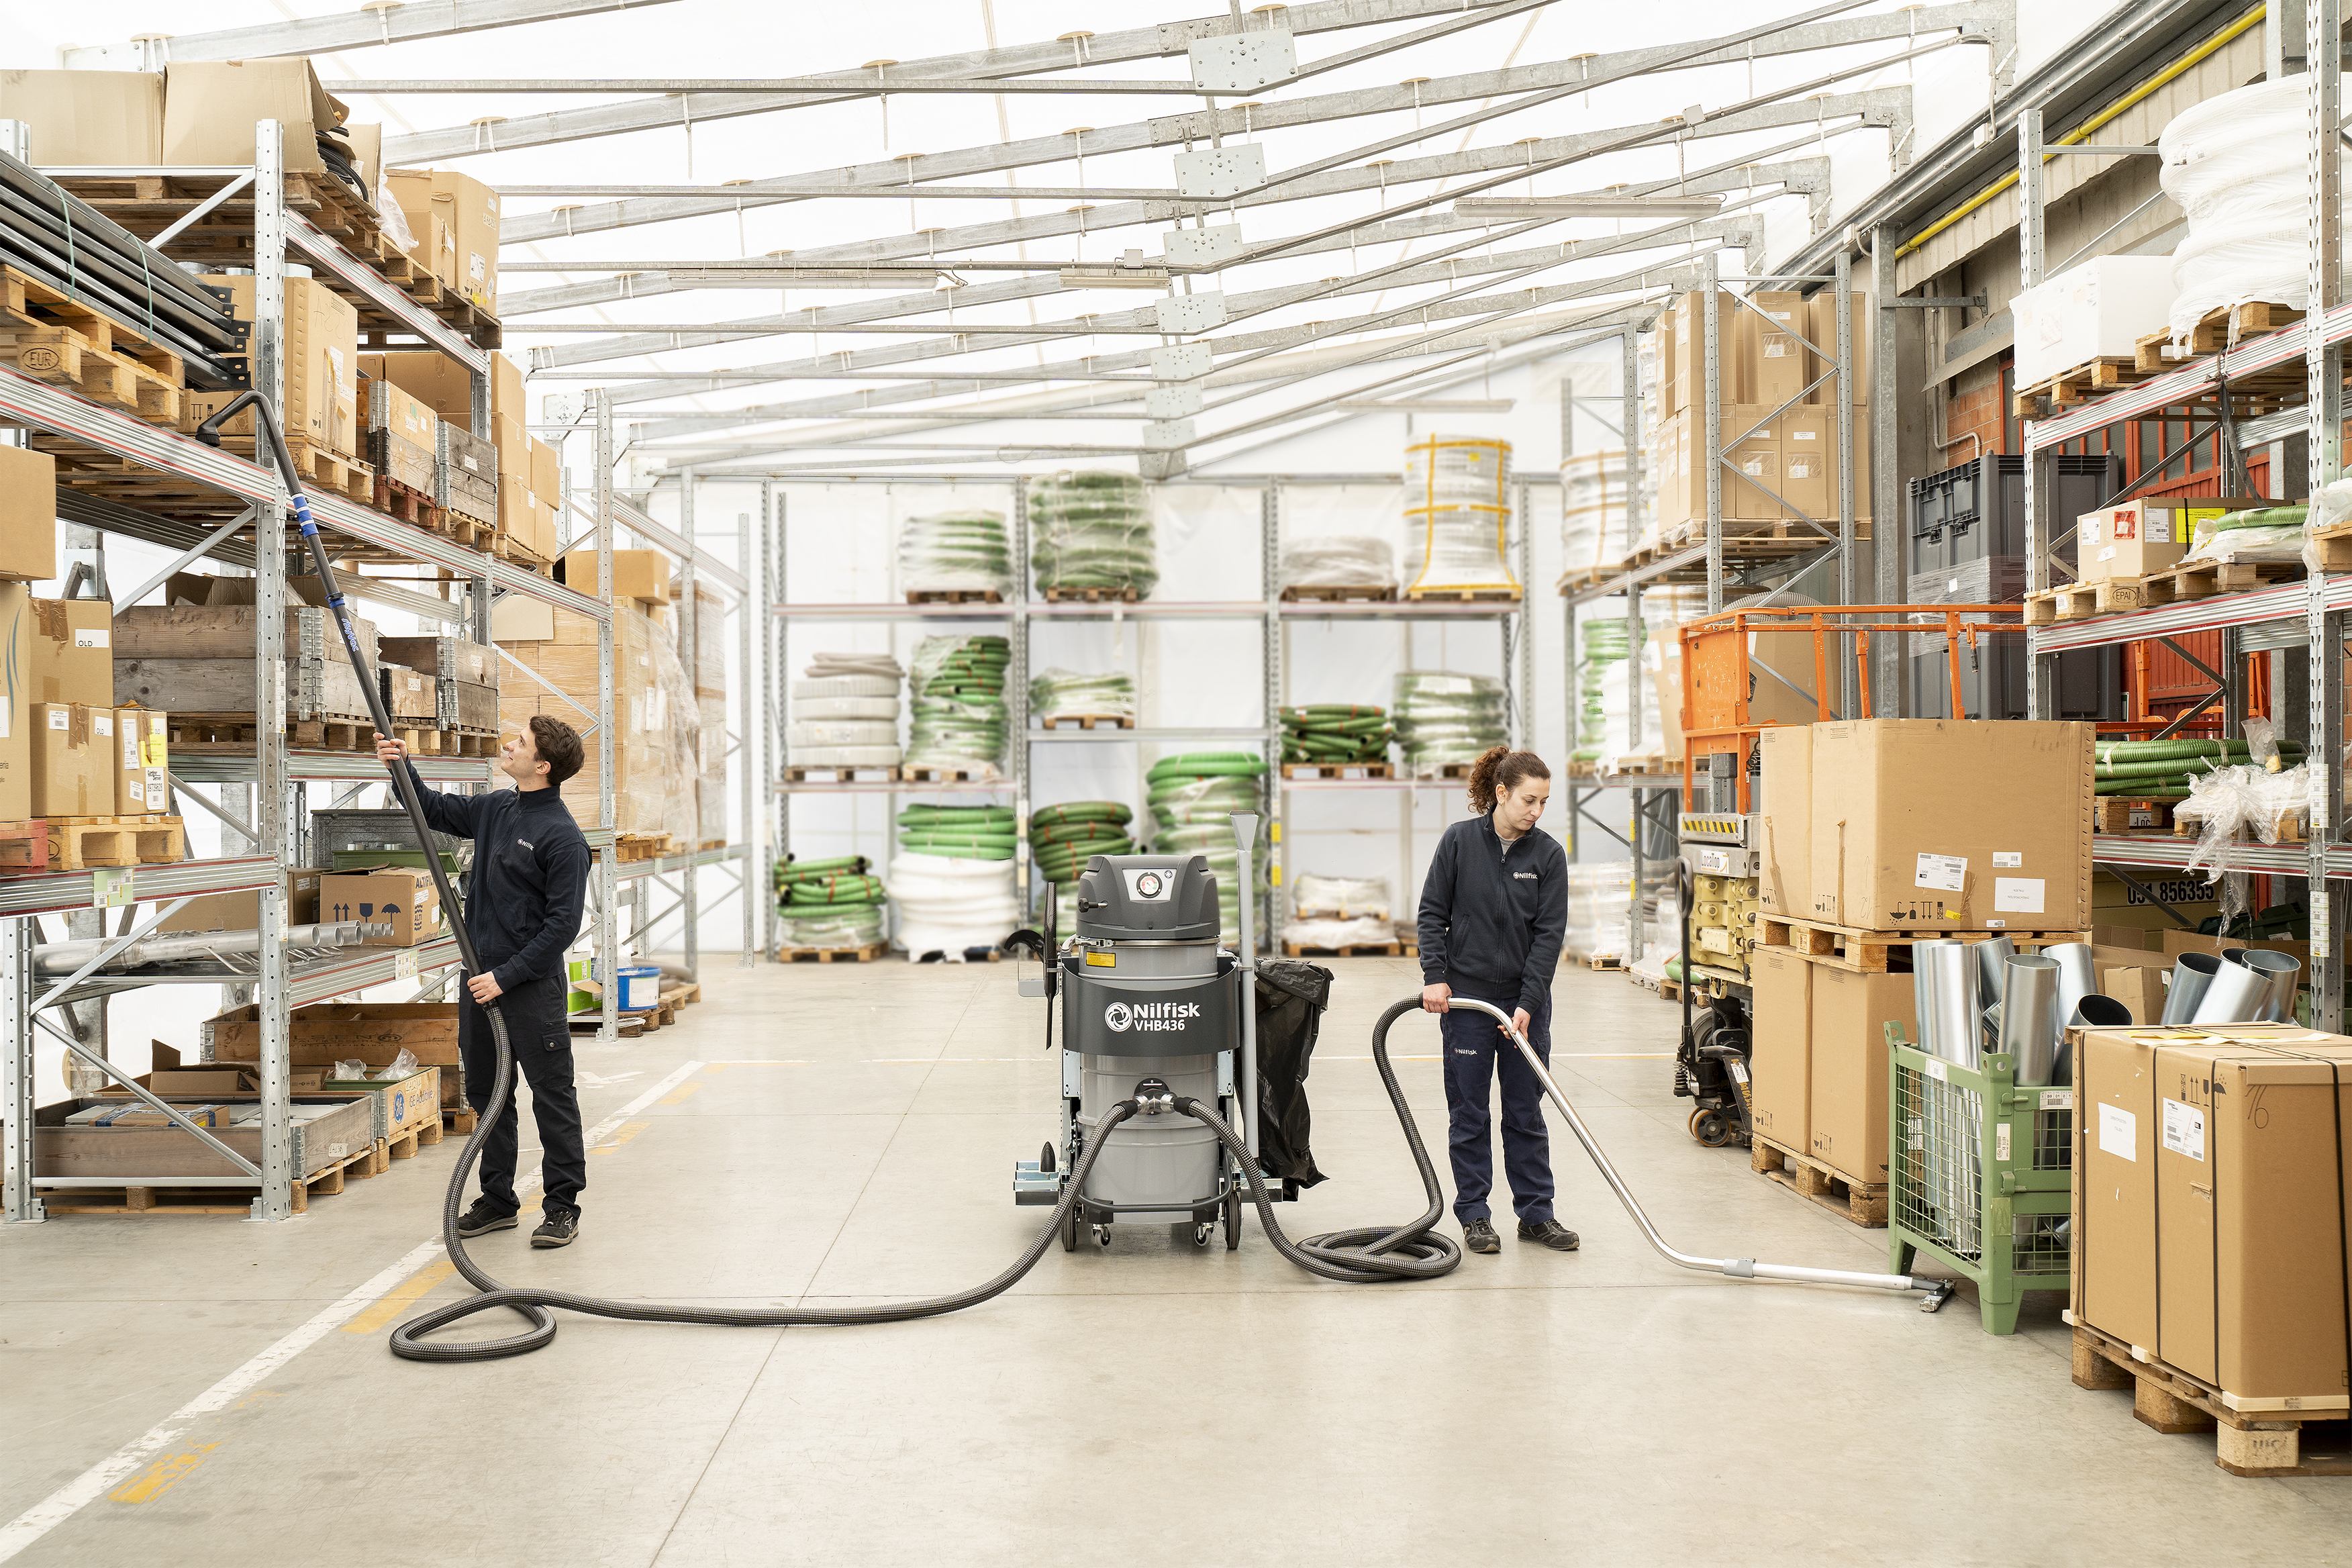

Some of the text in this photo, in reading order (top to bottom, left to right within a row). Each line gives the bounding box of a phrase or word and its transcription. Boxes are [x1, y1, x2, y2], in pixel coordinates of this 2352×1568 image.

[30, 352, 51, 366] EUR
[1701, 852, 1720, 872] LocaTop
[415, 874, 435, 889] ALTIFIL
[2159, 879, 2214, 903] 856355
[414, 914, 422, 922] ALTI
[1133, 1002, 1201, 1019] Nilfisk
[1134, 1020, 1185, 1032] VHB436
